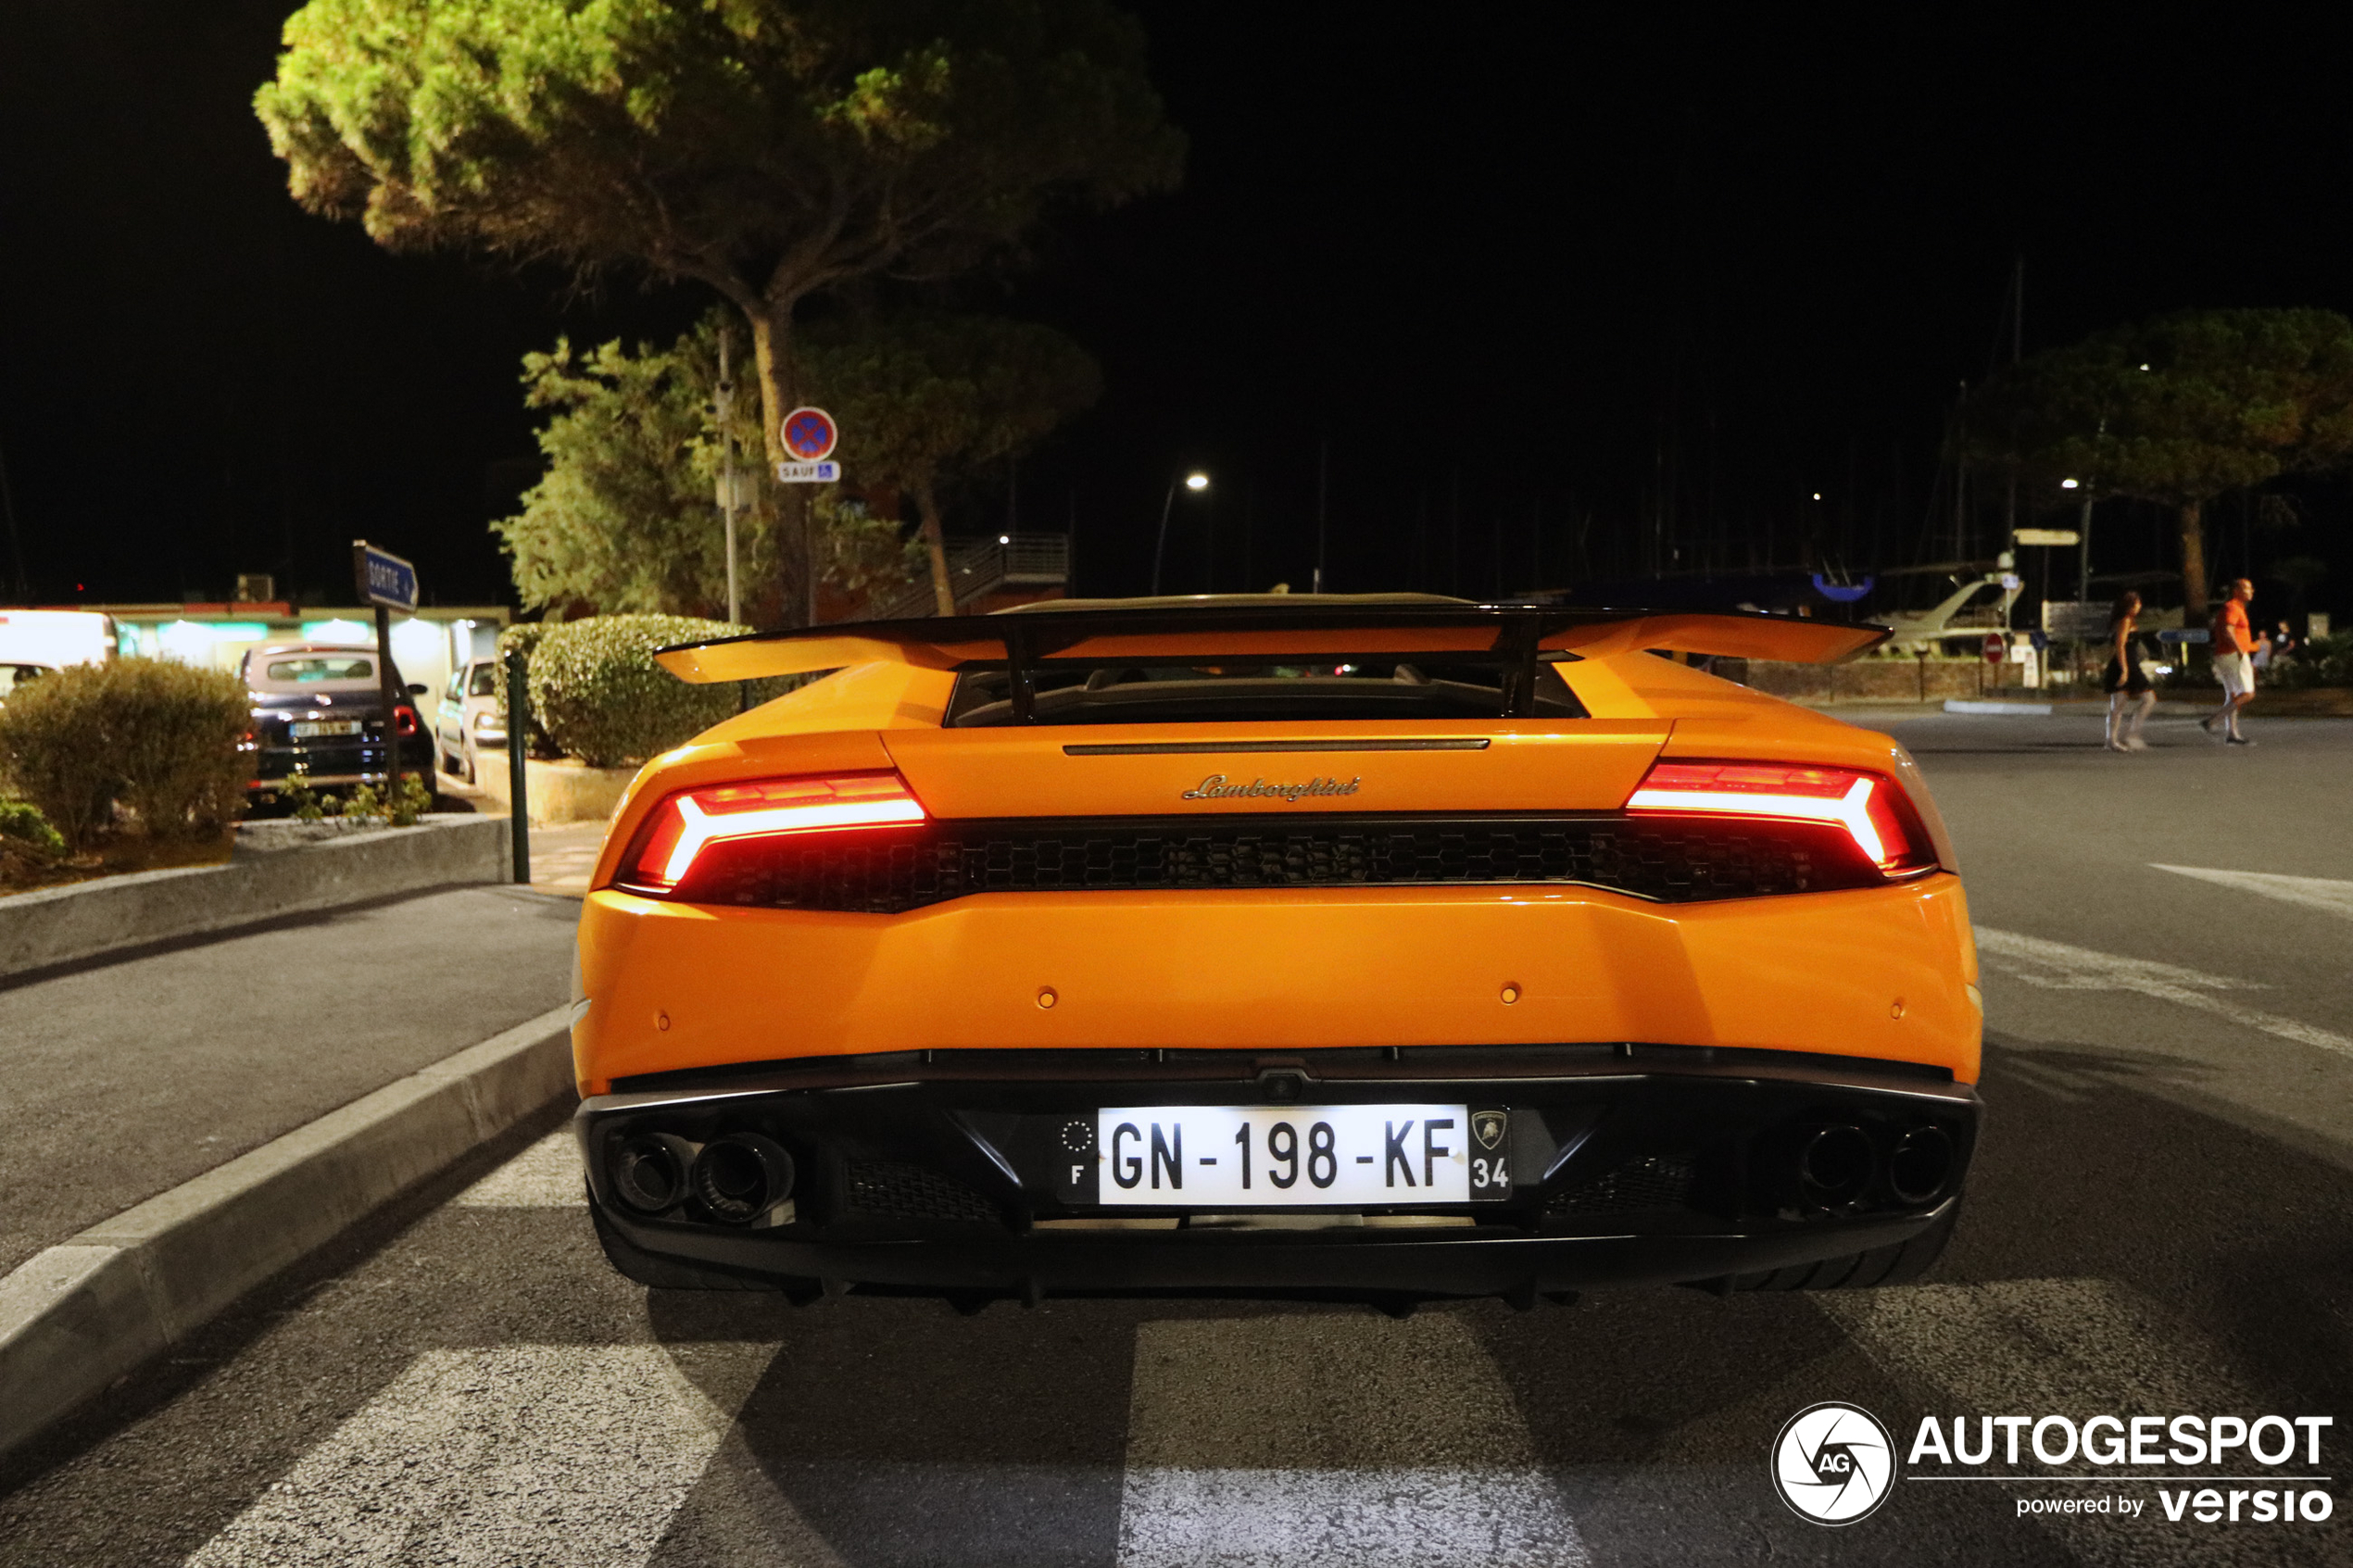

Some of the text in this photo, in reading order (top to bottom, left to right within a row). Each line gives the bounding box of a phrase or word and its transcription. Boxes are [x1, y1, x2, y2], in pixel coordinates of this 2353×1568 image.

[783, 466, 814, 478] SAUF
[1182, 774, 1361, 802] Lamborghini
[1072, 1165, 1085, 1185] F
[1473, 1158, 1508, 1188] 34
